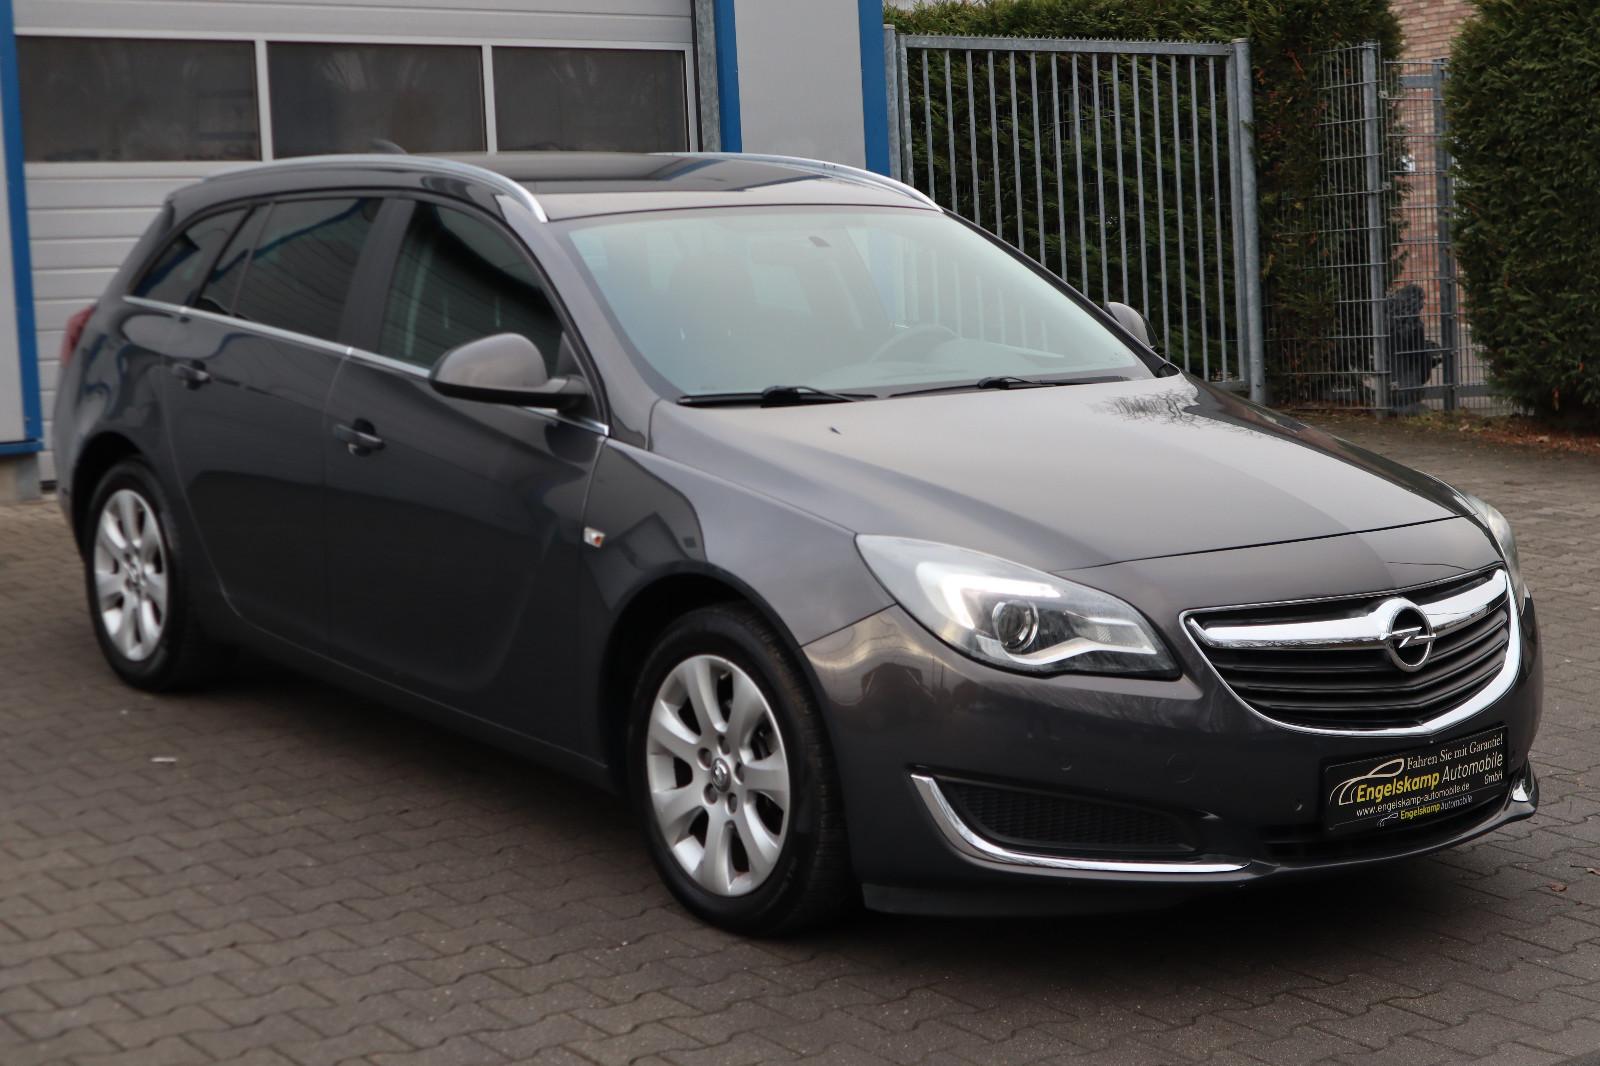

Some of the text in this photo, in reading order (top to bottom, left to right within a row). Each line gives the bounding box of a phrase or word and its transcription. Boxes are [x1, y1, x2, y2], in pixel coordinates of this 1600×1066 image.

[1407, 733, 1503, 771] Fahren Sie mit Garantie!
[1357, 751, 1503, 803] Engelskamp Automobile
[1484, 770, 1503, 785] GmbH
[1356, 782, 1470, 817] www.engelskamp-automobile.de
[1400, 794, 1473, 820] Engelskamp Automobile
